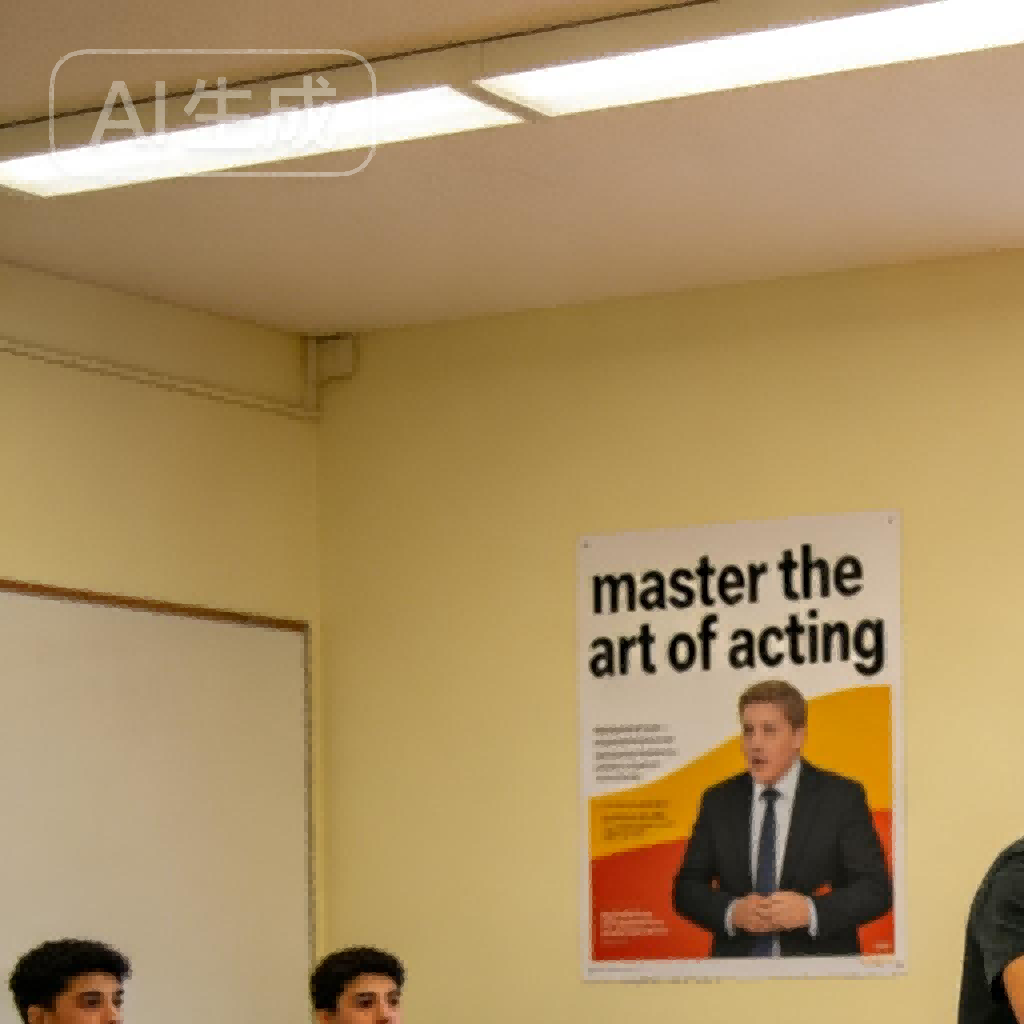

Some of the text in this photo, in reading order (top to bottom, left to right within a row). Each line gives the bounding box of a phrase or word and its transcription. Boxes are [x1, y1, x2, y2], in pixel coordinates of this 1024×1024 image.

[592, 543, 864, 615] master the
[589, 608, 885, 677] art of acting
